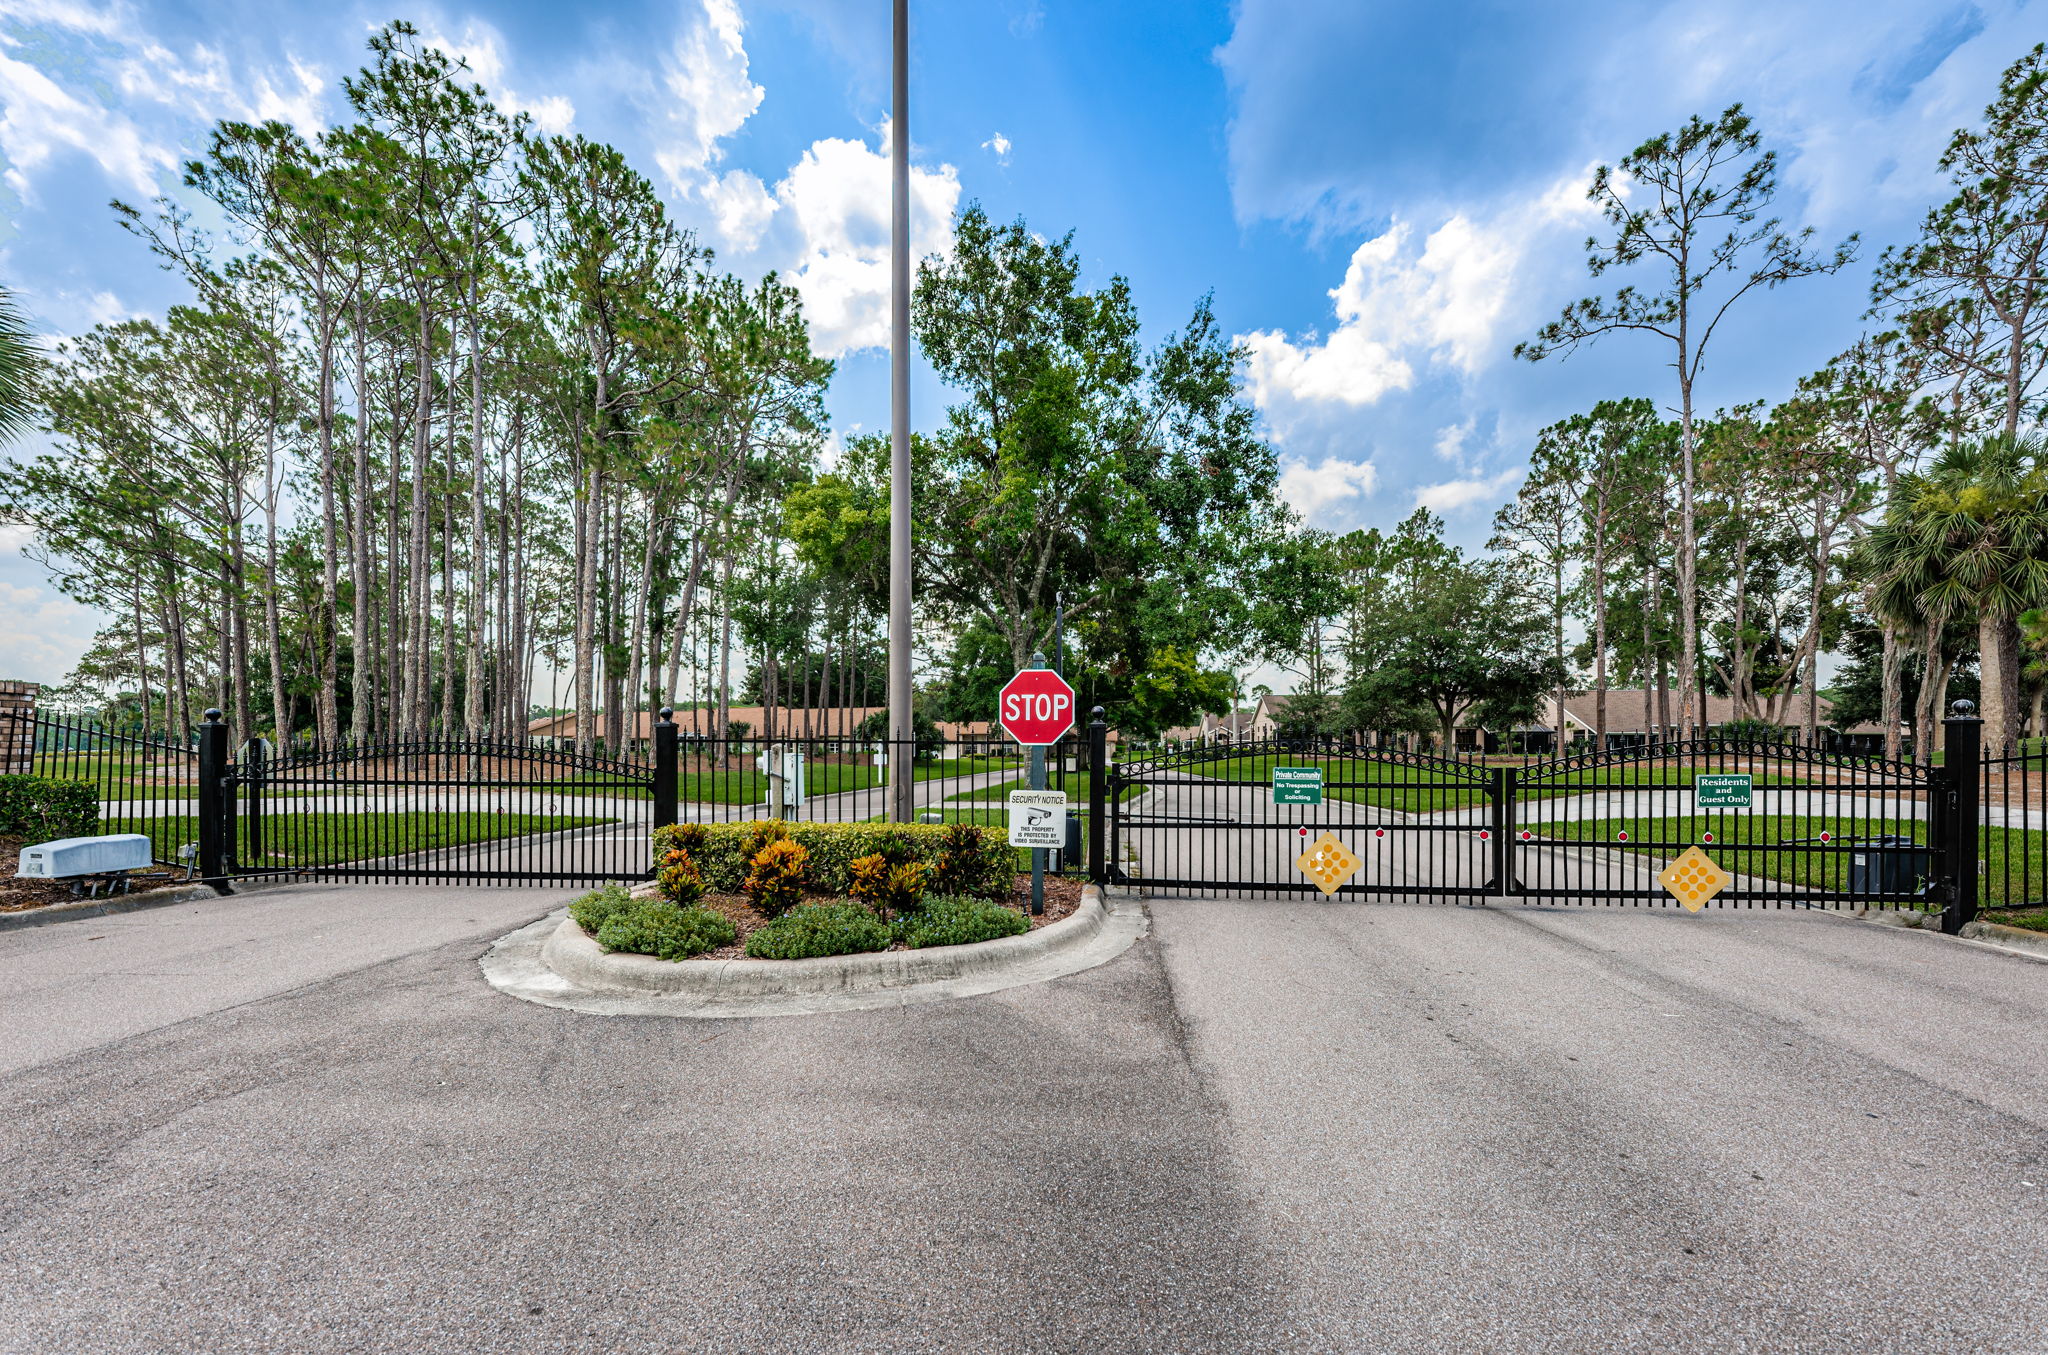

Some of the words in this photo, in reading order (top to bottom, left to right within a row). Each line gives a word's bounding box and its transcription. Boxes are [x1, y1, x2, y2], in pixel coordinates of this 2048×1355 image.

[1005, 693, 1069, 721] STOP
[1293, 771, 1320, 780] Community
[1701, 778, 1749, 786] Residents
[1011, 795, 1041, 804] SECURITY
[1042, 796, 1064, 805] NOTICE
[1727, 795, 1750, 804] Only
